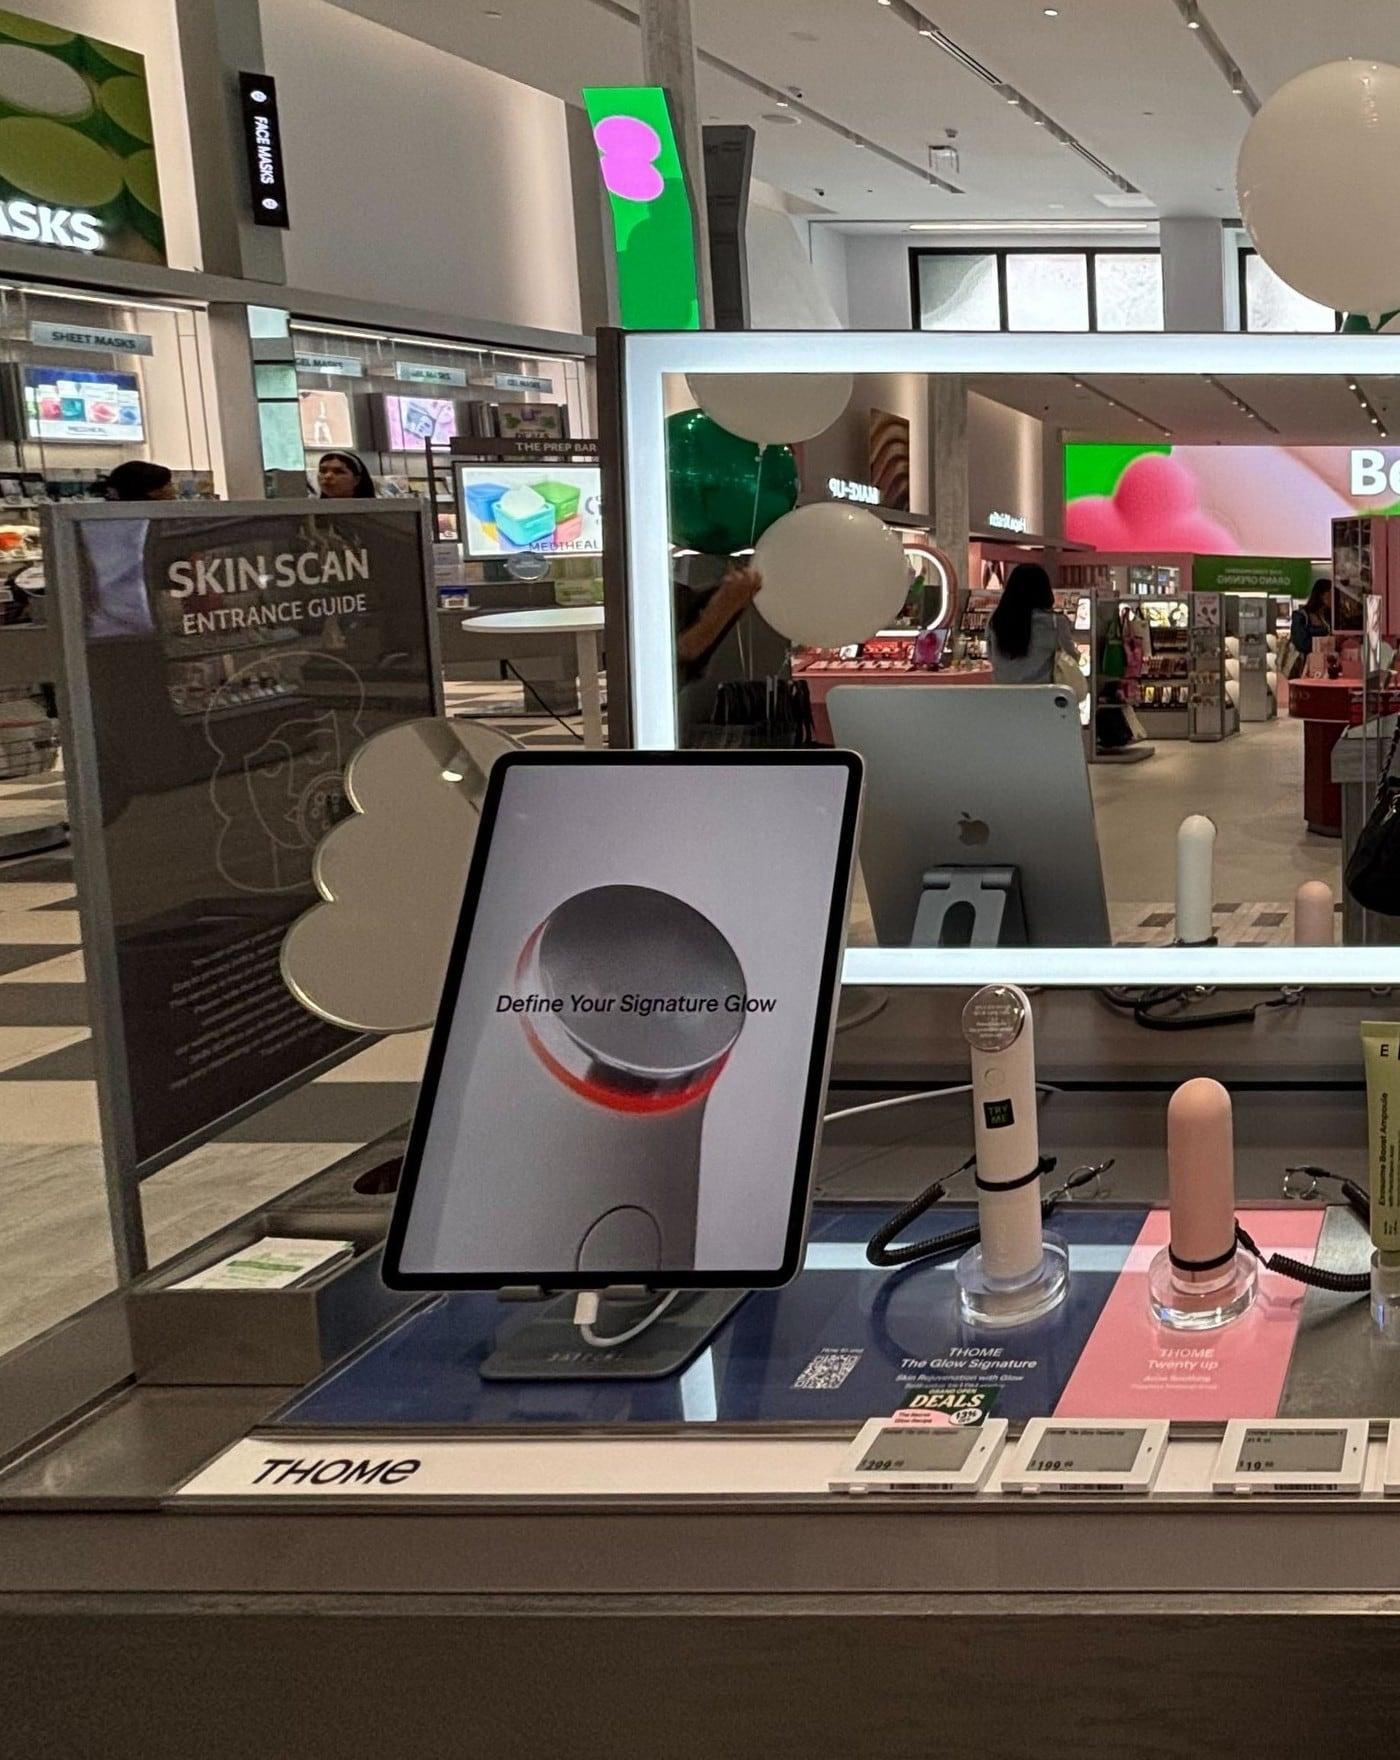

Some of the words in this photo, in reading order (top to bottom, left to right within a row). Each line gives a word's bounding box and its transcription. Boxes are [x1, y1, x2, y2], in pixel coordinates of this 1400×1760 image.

[254, 115, 271, 145] FACE
[257, 145, 275, 185] MASKS
[52, 331, 92, 344] SHEET
[94, 335, 136, 349] MASKS
[313, 358, 344, 369] MASKS
[515, 441, 541, 451] THE
[543, 442, 571, 451] PREP
[575, 443, 597, 452] BAR
[528, 541, 599, 551] MEDIHEAL
[168, 555, 267, 599] SKIN
[274, 548, 370, 588] SCAN
[182, 601, 304, 636] ENTRANCE
[307, 593, 367, 617] GUIDE
[496, 994, 563, 1013] Define
[570, 994, 615, 1013] Your
[619, 994, 718, 1016] Signature
[724, 994, 777, 1013] Glow
[987, 1104, 1009, 1116] TRY
[1380, 1092, 1388, 1133] Ampoule
[949, 1347, 1004, 1358] THOME
[1160, 1348, 1215, 1358] THOME
[900, 1358, 928, 1369] The
[930, 1358, 967, 1369] Glow
[968, 1358, 1037, 1371] Signature
[1147, 1360, 1197, 1371] Twenty
[1200, 1361, 1218, 1371] up
[895, 1374, 917, 1382] Skin
[979, 1374, 999, 1382] with
[1000, 1374, 1025, 1382] Glow
[909, 1394, 985, 1408] DEALS
